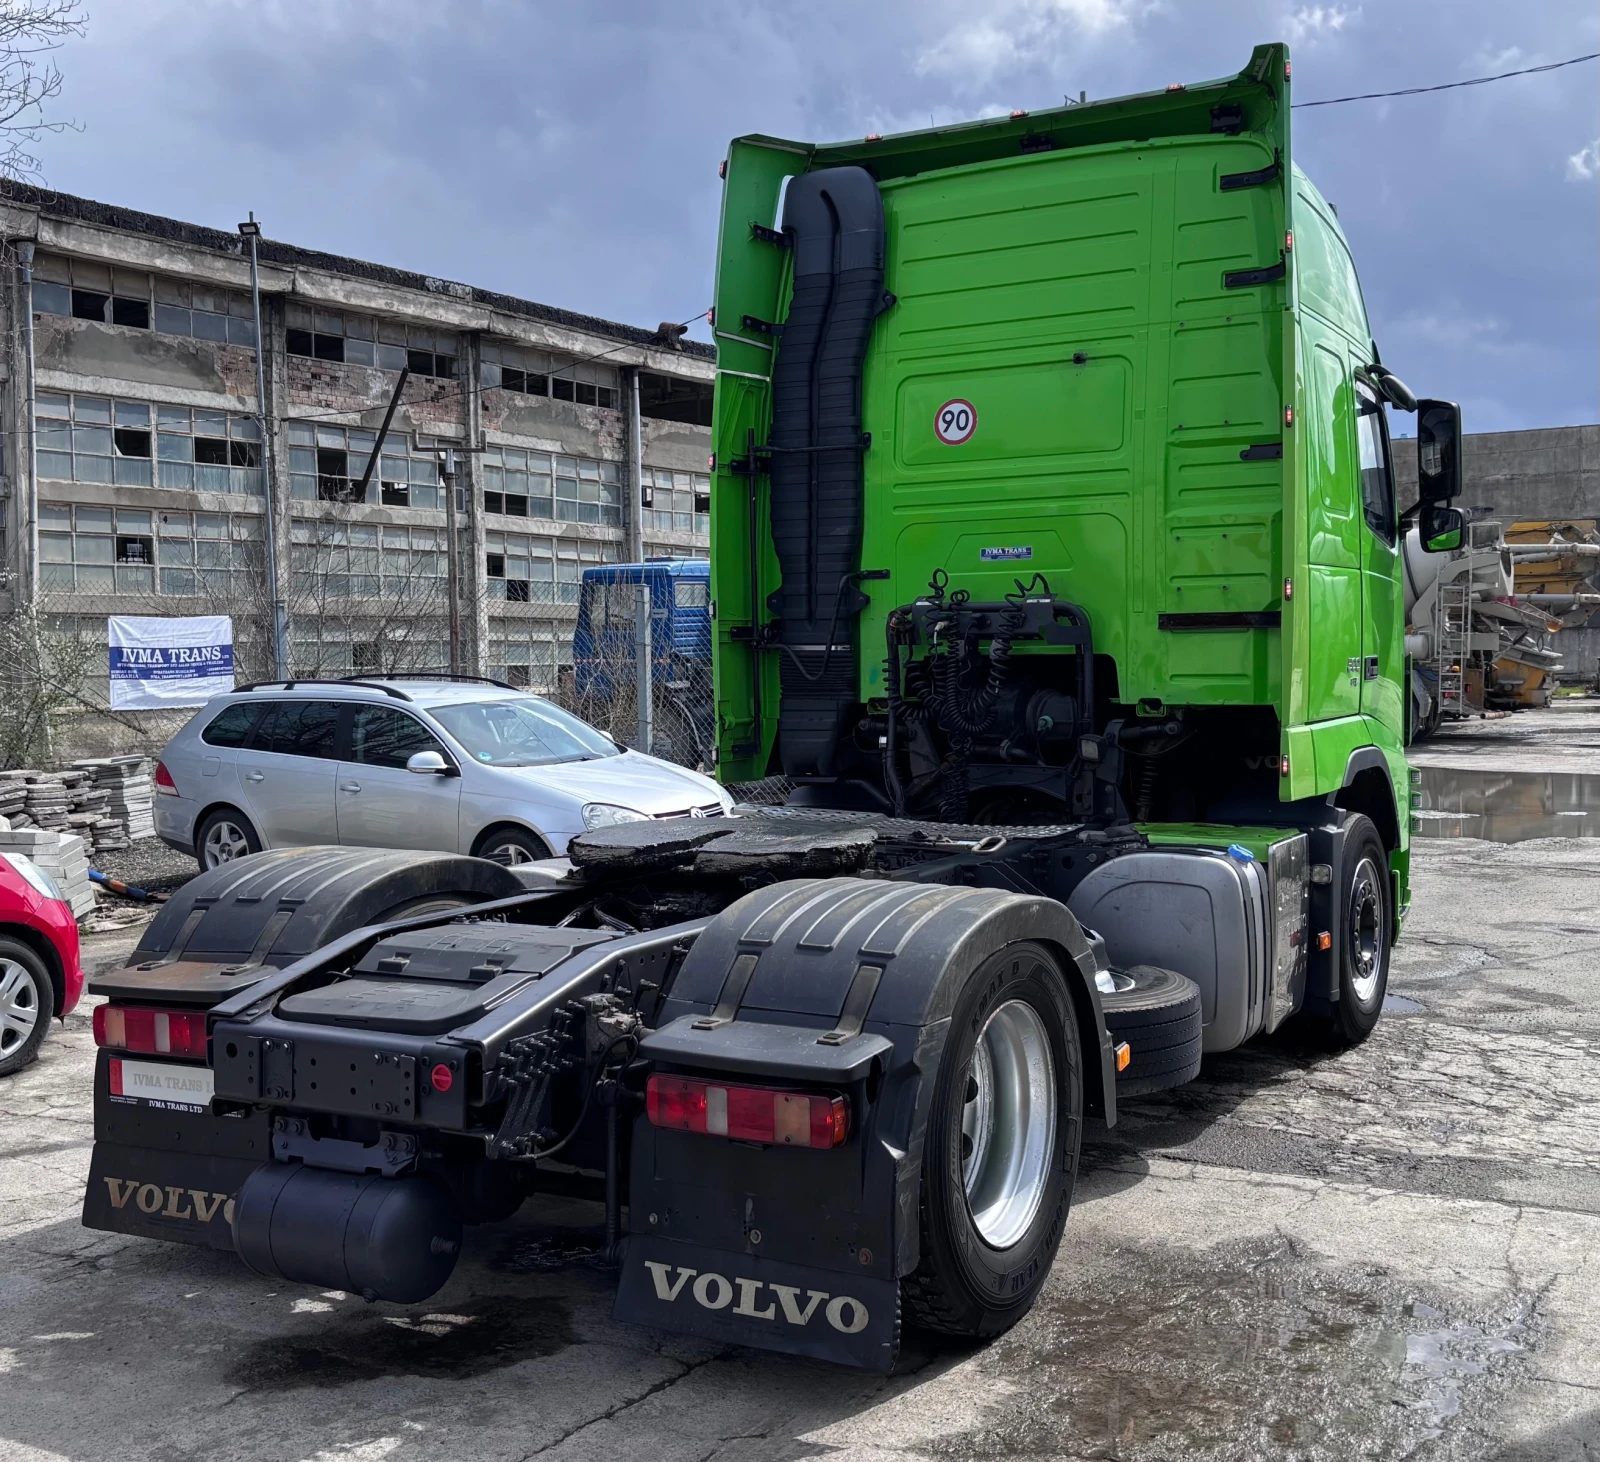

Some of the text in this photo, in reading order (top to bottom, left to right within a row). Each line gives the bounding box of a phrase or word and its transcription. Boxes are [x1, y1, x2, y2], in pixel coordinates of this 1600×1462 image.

[942, 409, 970, 433] 90
[121, 648, 164, 663] IVMA
[168, 646, 221, 663] TRANS
[133, 1073, 162, 1088] IVMA
[165, 1077, 203, 1093] TRANS
[149, 1100, 166, 1109] IVMA
[167, 1102, 189, 1112] TRANS
[189, 1105, 203, 1114] LTD
[644, 1260, 870, 1334] VOLVO
